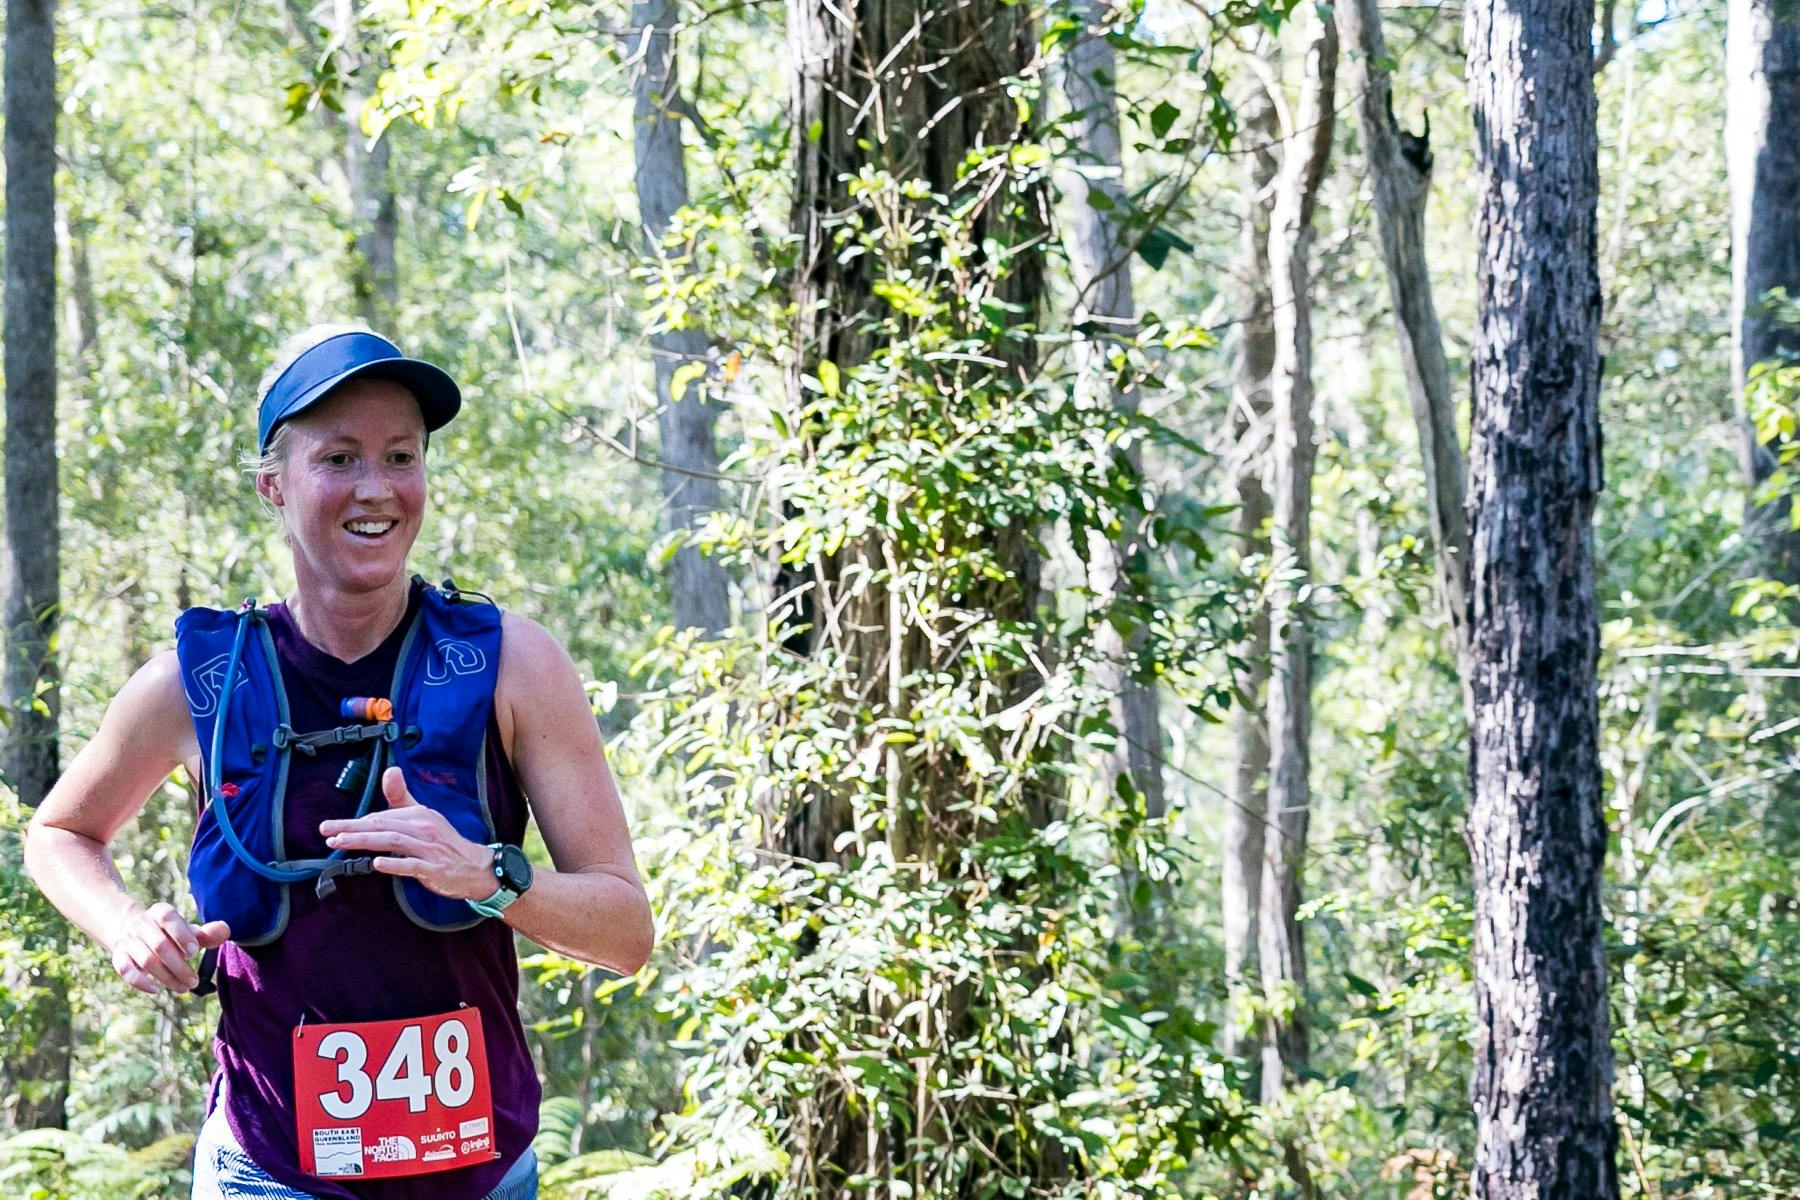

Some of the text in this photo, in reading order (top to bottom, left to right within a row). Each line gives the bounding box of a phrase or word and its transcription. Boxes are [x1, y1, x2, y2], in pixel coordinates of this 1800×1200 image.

[317, 1019, 475, 1119] 348
[378, 1136, 398, 1146] THE
[420, 1130, 456, 1144] SUUNTO
[364, 1143, 398, 1155] NORTH
[373, 1154, 399, 1162] FACE
